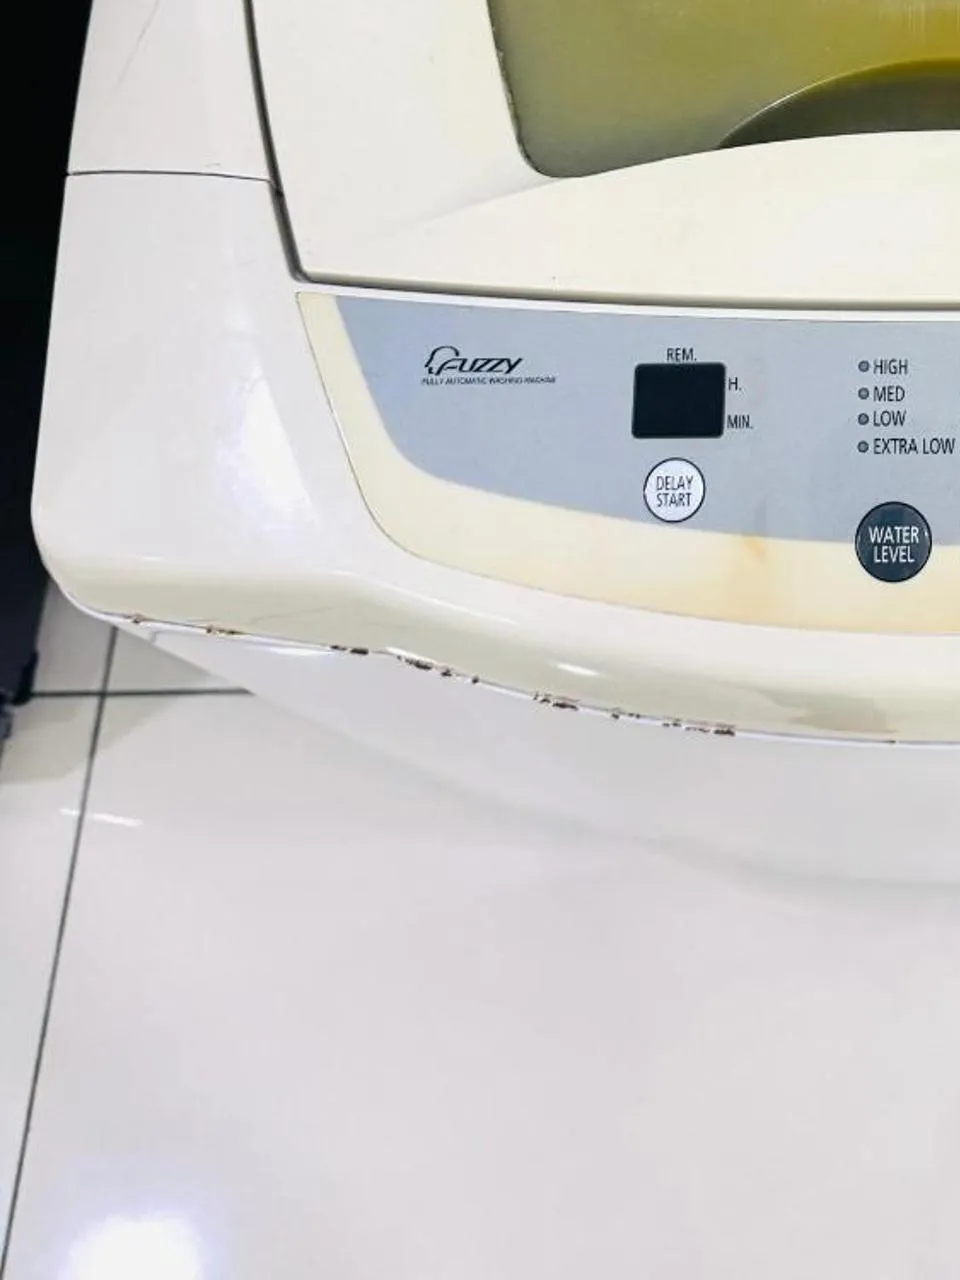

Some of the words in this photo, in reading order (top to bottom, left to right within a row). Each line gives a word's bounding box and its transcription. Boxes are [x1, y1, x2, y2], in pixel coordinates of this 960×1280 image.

[666, 348, 697, 363] REM.
[873, 359, 909, 375] HIGH
[728, 378, 742, 392] H.
[873, 386, 905, 402] MED
[727, 415, 754, 430] MIN.
[873, 411, 906, 427] LOW
[873, 438, 918, 454] EXTRA
[922, 438, 956, 455] LOW
[656, 475, 694, 492] DELAY
[656, 493, 693, 508] START
[868, 526, 919, 545] WATER
[873, 546, 915, 564] LEVEL
